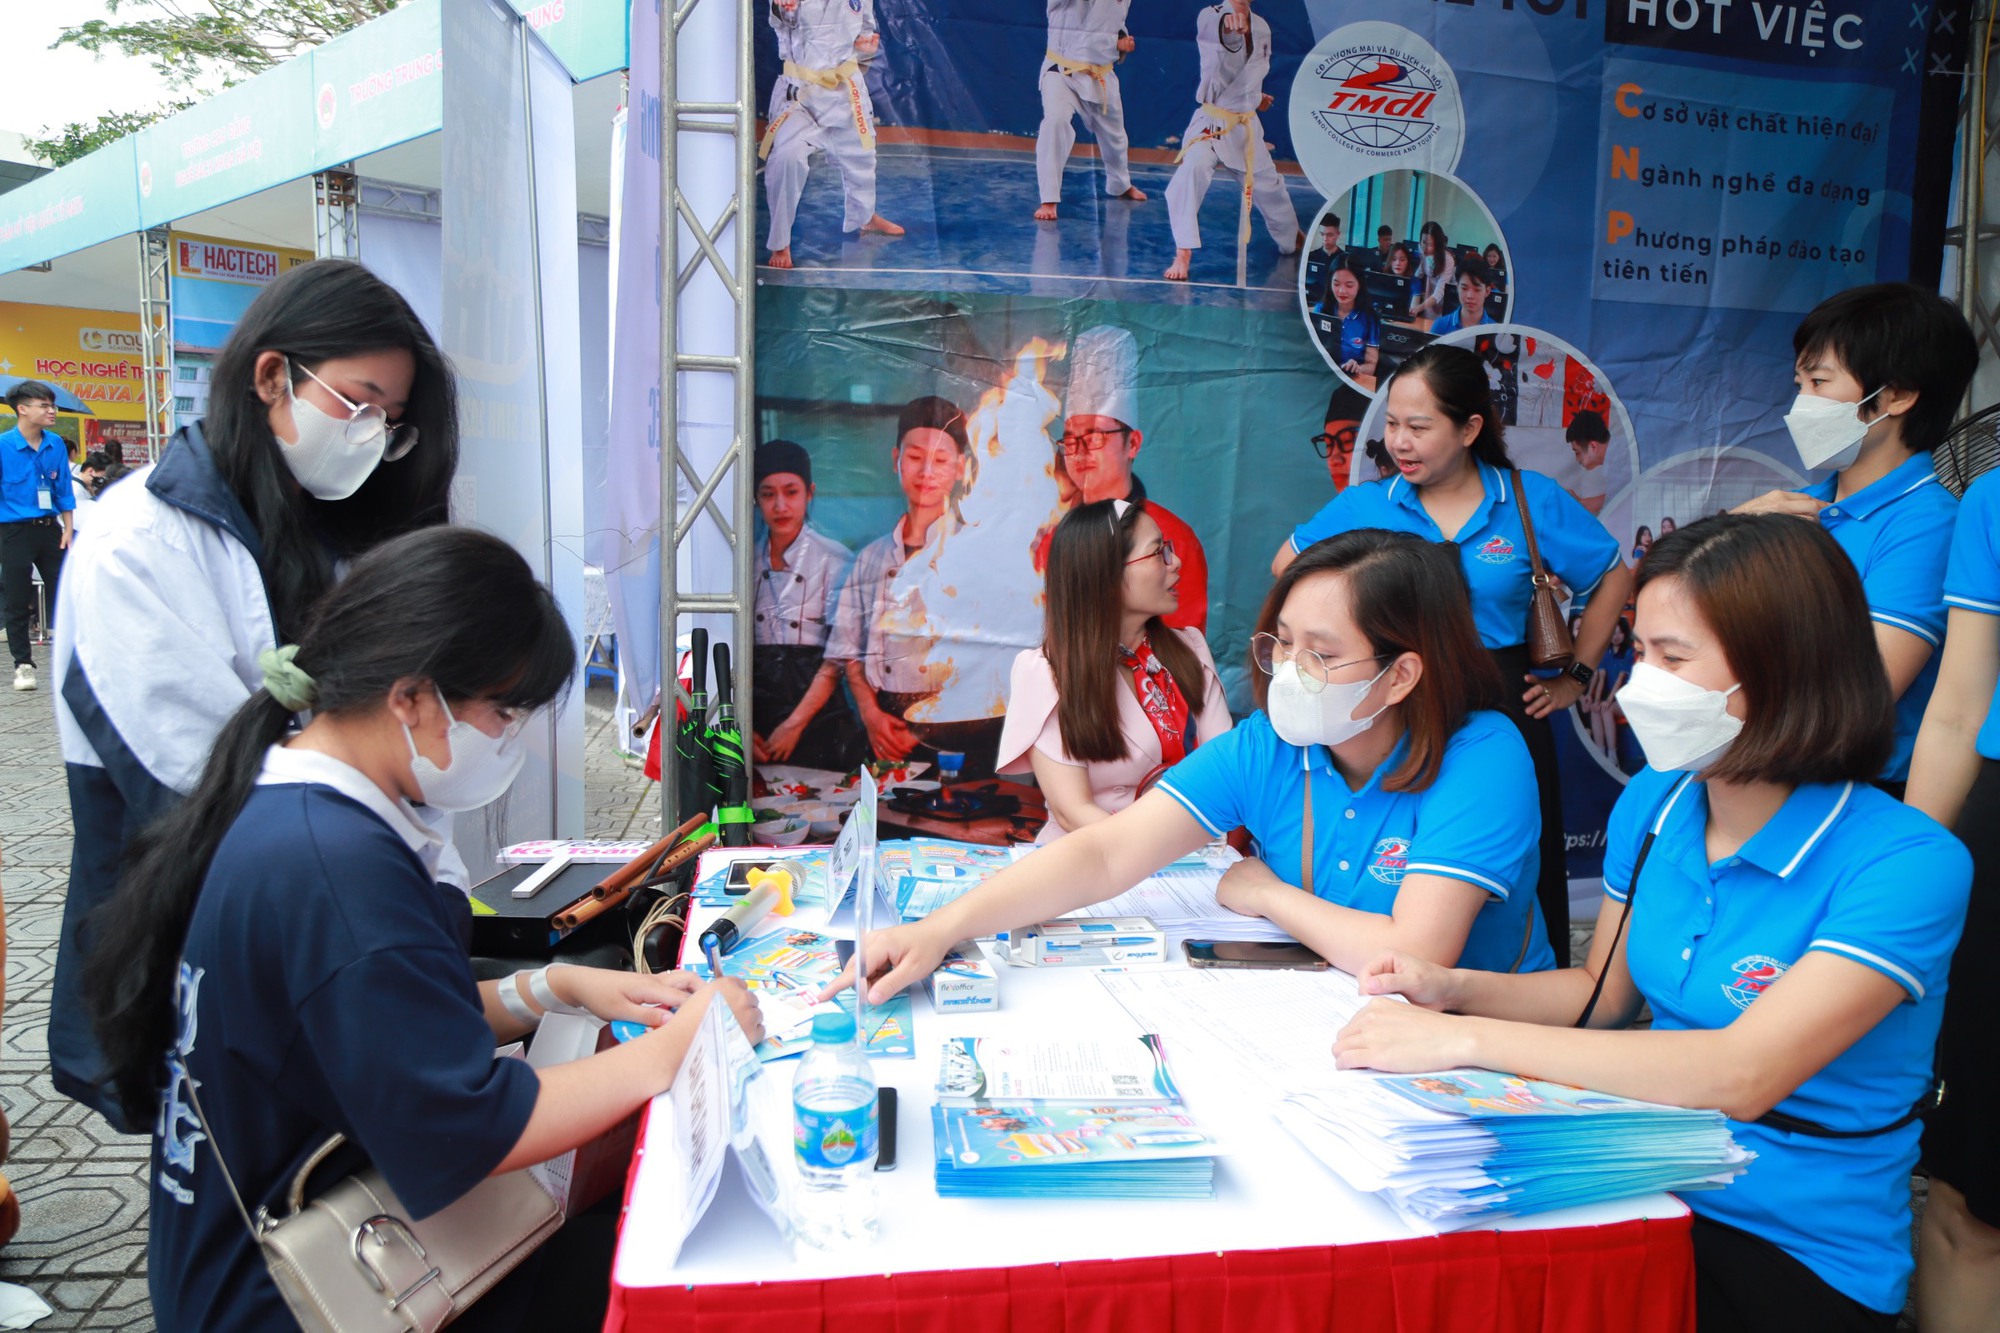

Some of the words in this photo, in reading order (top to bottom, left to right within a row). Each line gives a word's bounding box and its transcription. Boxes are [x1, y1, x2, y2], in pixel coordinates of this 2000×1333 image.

[1753, 0, 1865, 58] VIỆC
[395, 53, 433, 87] TRUNG
[1315, 63, 1326, 75] CĐ
[1325, 46, 1358, 65] THƯƠNG
[1377, 45, 1387, 53] VÀ
[1389, 48, 1400, 58] DU
[1310, 111, 1328, 131] HANOI
[1328, 131, 1354, 151] COLLEGE
[1356, 146, 1365, 154] OF
[1366, 149, 1402, 157] COMMERCE
[1404, 145, 1417, 155] AND
[1418, 124, 1441, 147] TOURISM
[1663, 102, 1688, 124] sở
[1696, 108, 1729, 132] vật
[1736, 112, 1788, 134] chất
[1797, 115, 1846, 140] hiện
[1850, 122, 1879, 146] đại
[1712, 171, 1776, 194] nghề
[1787, 175, 1814, 195] đa
[1820, 179, 1870, 206] dạng
[205, 245, 277, 276] HACTECH
[1721, 234, 1782, 260] pháp
[1788, 240, 1822, 260] đào
[1829, 245, 1866, 267] tạo
[1603, 258, 1650, 281] tiên
[1660, 262, 1708, 284] tiến
[1387, 332, 1411, 343] acer
[36, 359, 77, 377] HỌC
[81, 360, 129, 378] NGHỀ
[74, 384, 132, 403] MAYA
[1563, 829, 1608, 852] ps://
